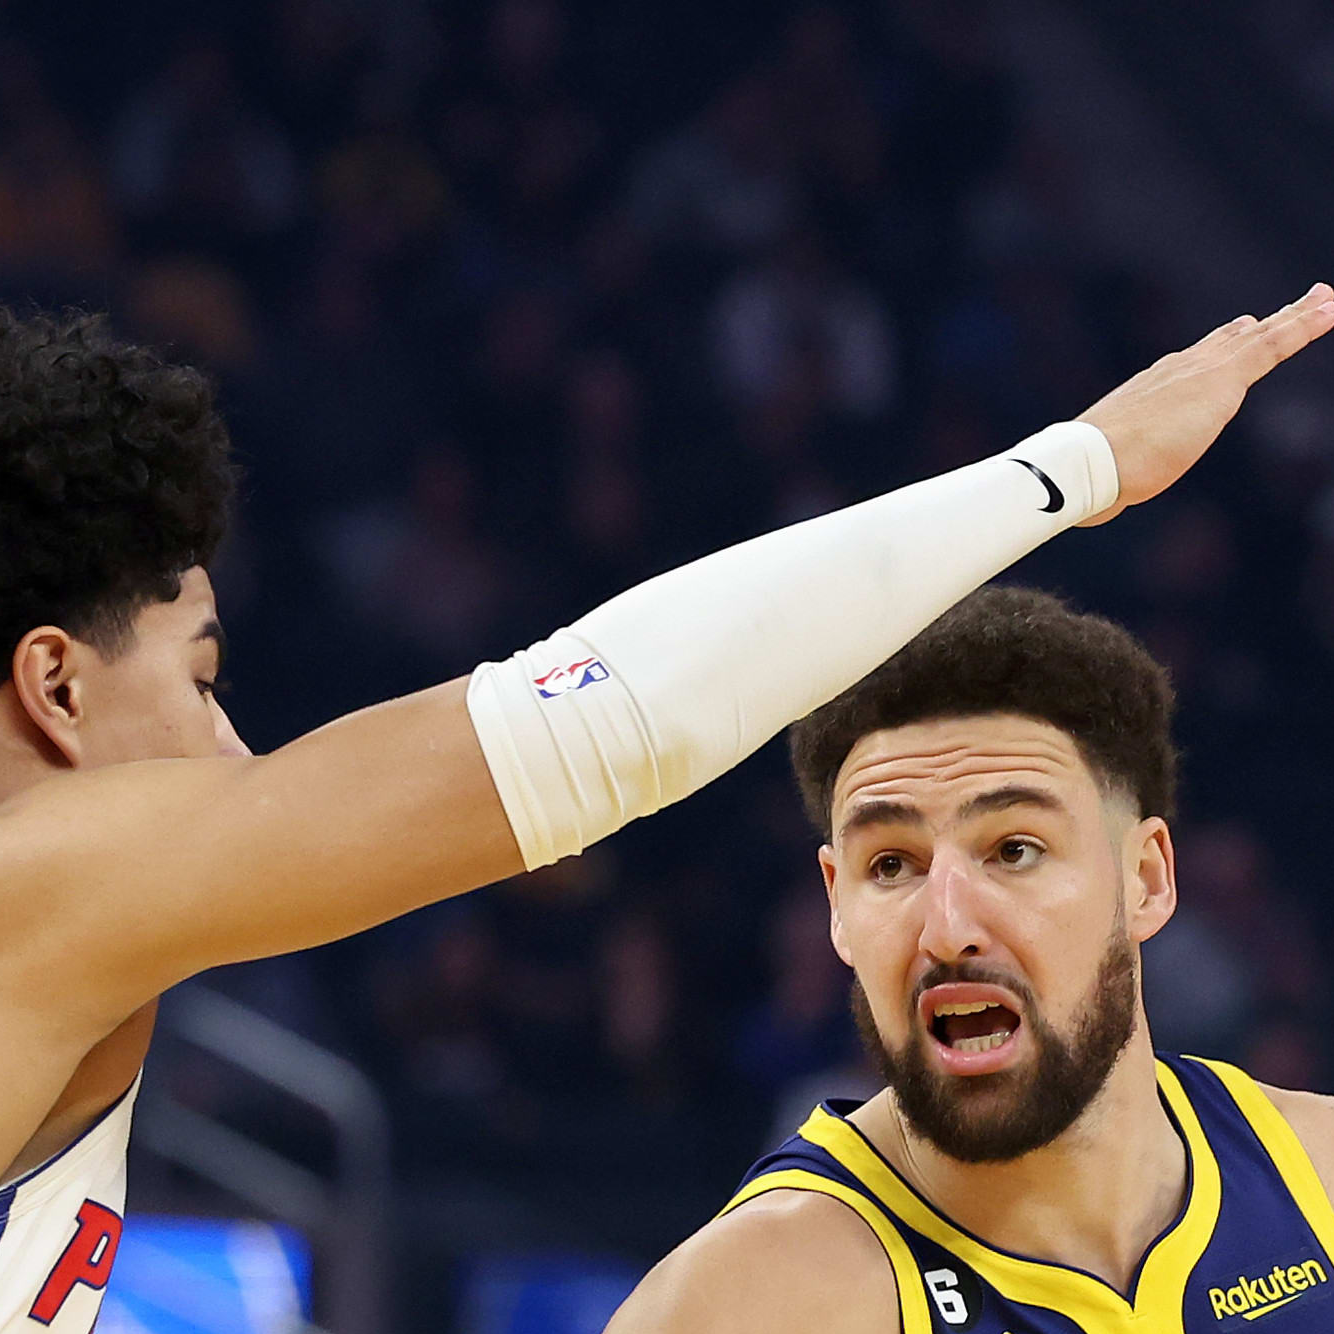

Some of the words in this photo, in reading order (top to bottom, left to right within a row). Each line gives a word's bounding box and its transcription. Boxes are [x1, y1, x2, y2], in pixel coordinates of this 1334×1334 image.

[28, 1198, 124, 1328] P
[1208, 1259, 1328, 1321] Rakuten
[924, 1268, 968, 1324] 6
